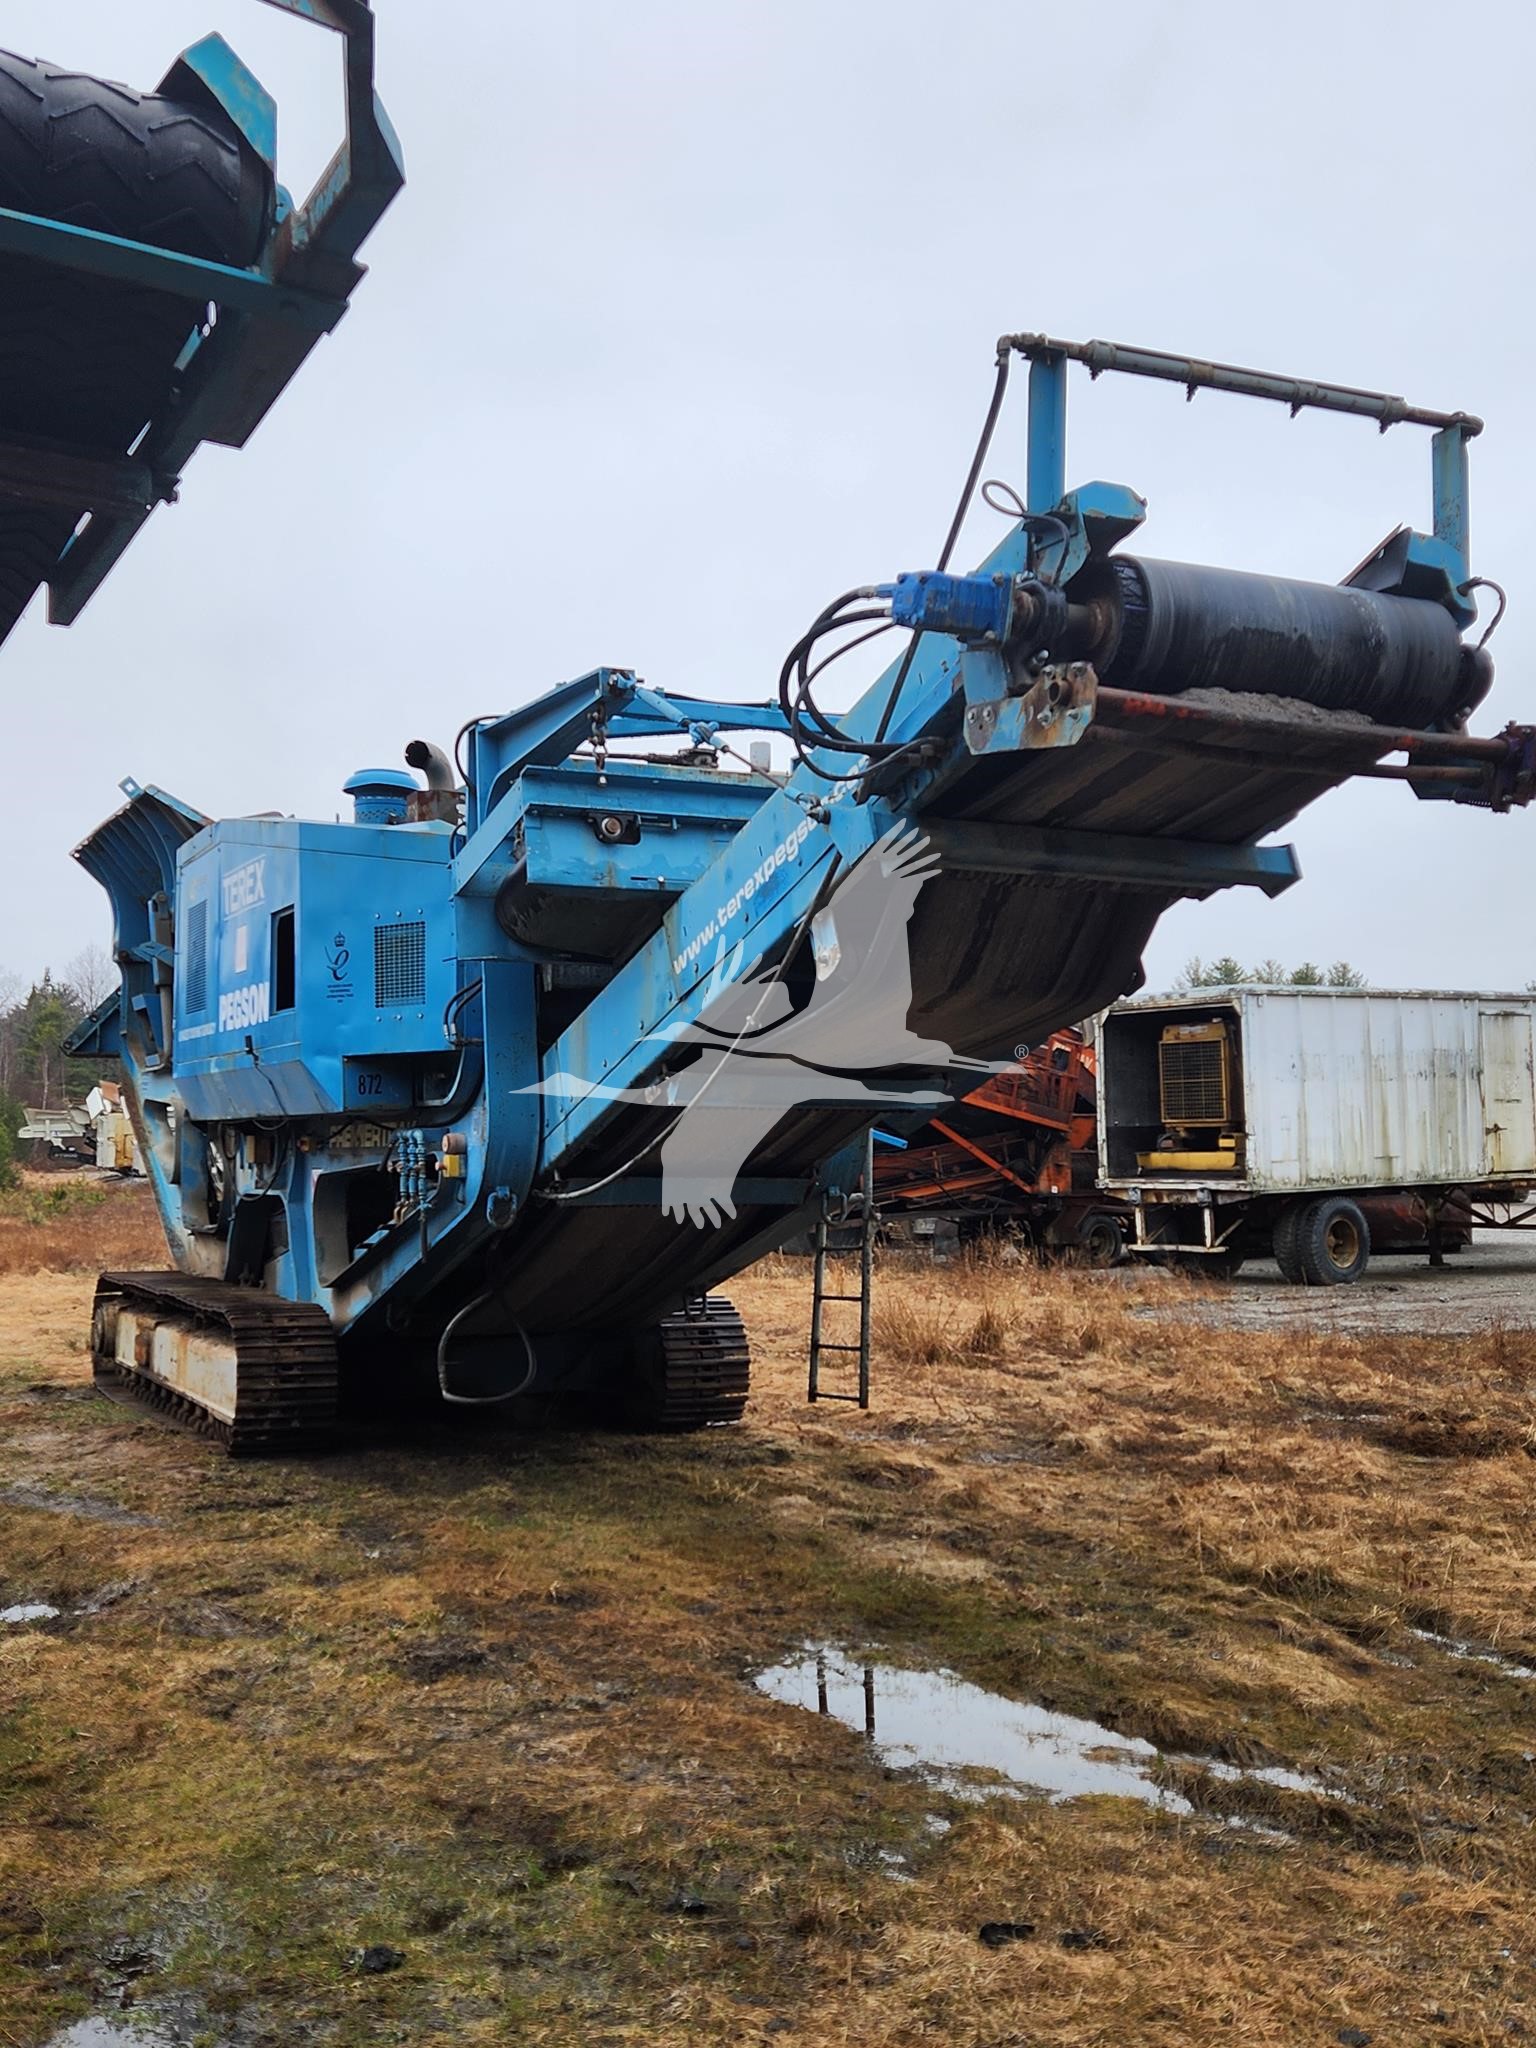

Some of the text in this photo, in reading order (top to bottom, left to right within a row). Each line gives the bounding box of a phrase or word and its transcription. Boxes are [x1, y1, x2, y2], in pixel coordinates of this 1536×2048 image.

[223, 859, 266, 916] TEREX
[673, 754, 871, 975] www.terexpegso.co
[218, 982, 270, 1033] PEGSON
[358, 1074, 383, 1096] 872
